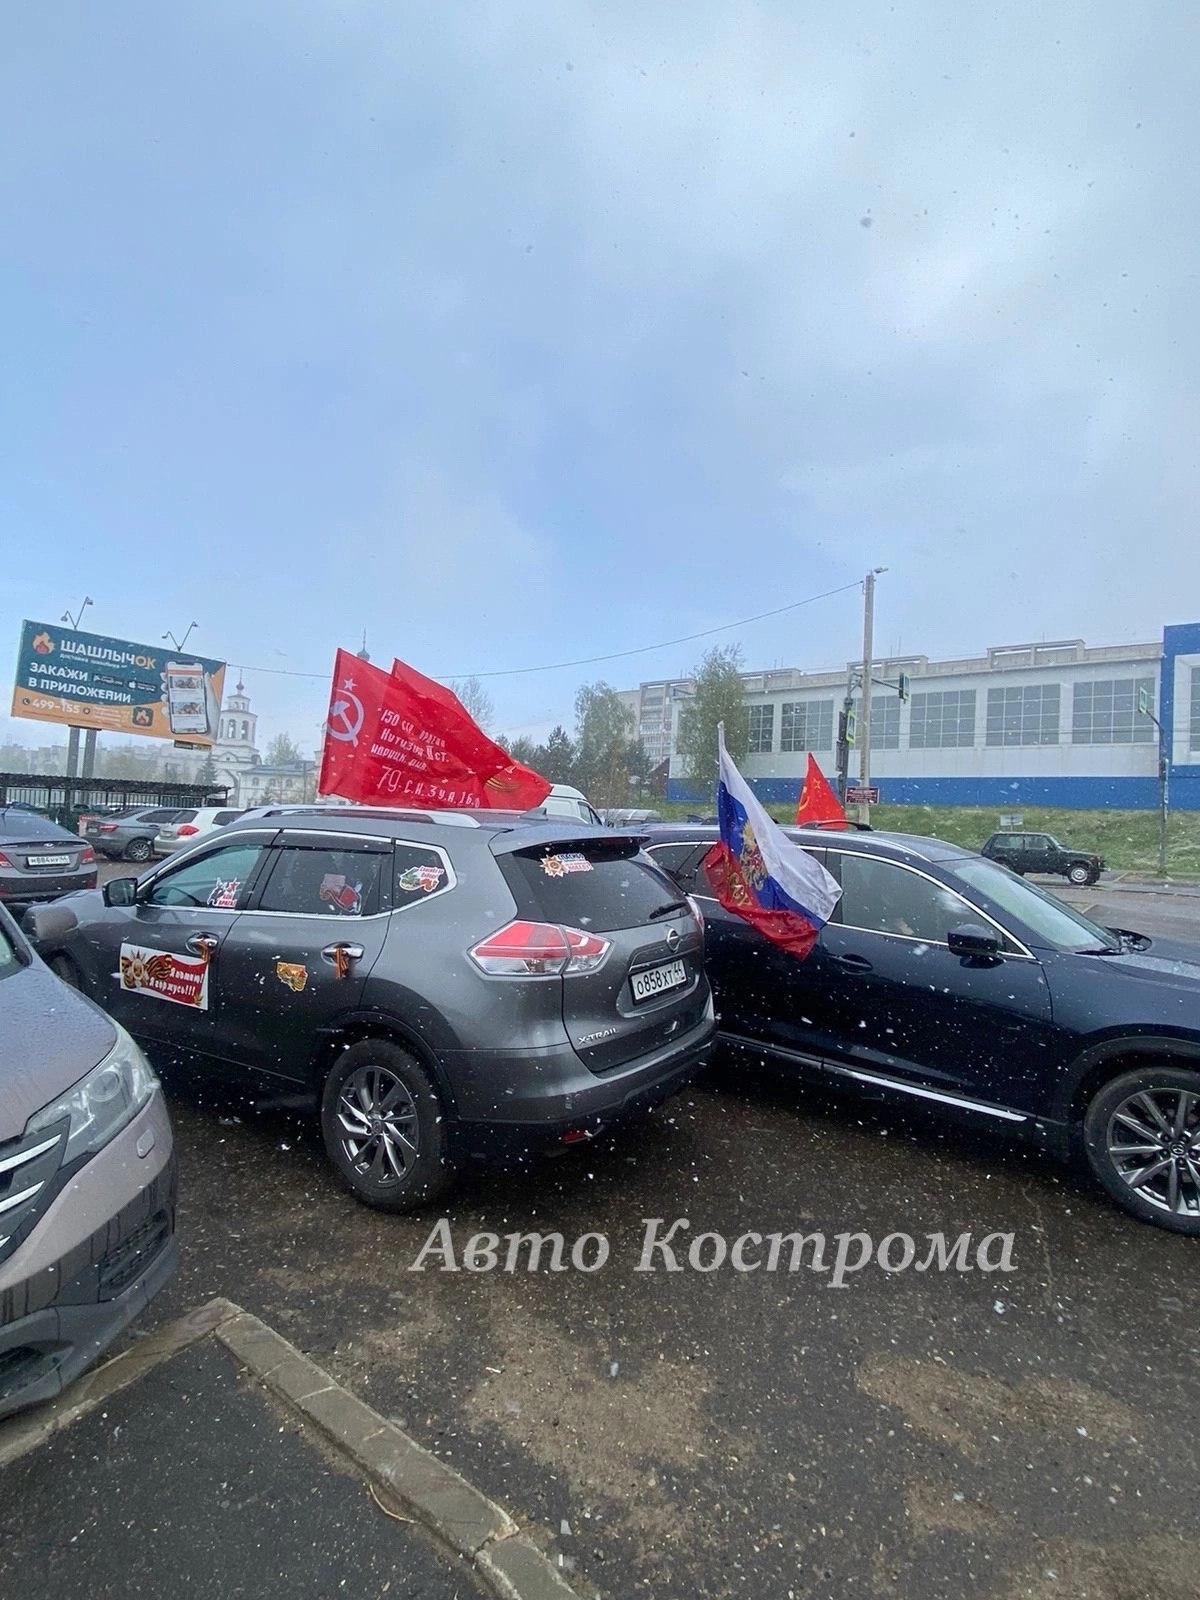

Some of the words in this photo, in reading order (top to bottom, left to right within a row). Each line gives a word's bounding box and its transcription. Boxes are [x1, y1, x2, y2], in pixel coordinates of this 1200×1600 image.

[60, 639, 157, 670] ШАШЛЫЧОК
[29, 662, 89, 681] ЗАКАЖИ
[28, 677, 38, 688] В
[32, 699, 81, 714] 499-155
[380, 709, 400, 726] 150
[169, 967, 176, 978] Я
[149, 976, 156, 987] Я
